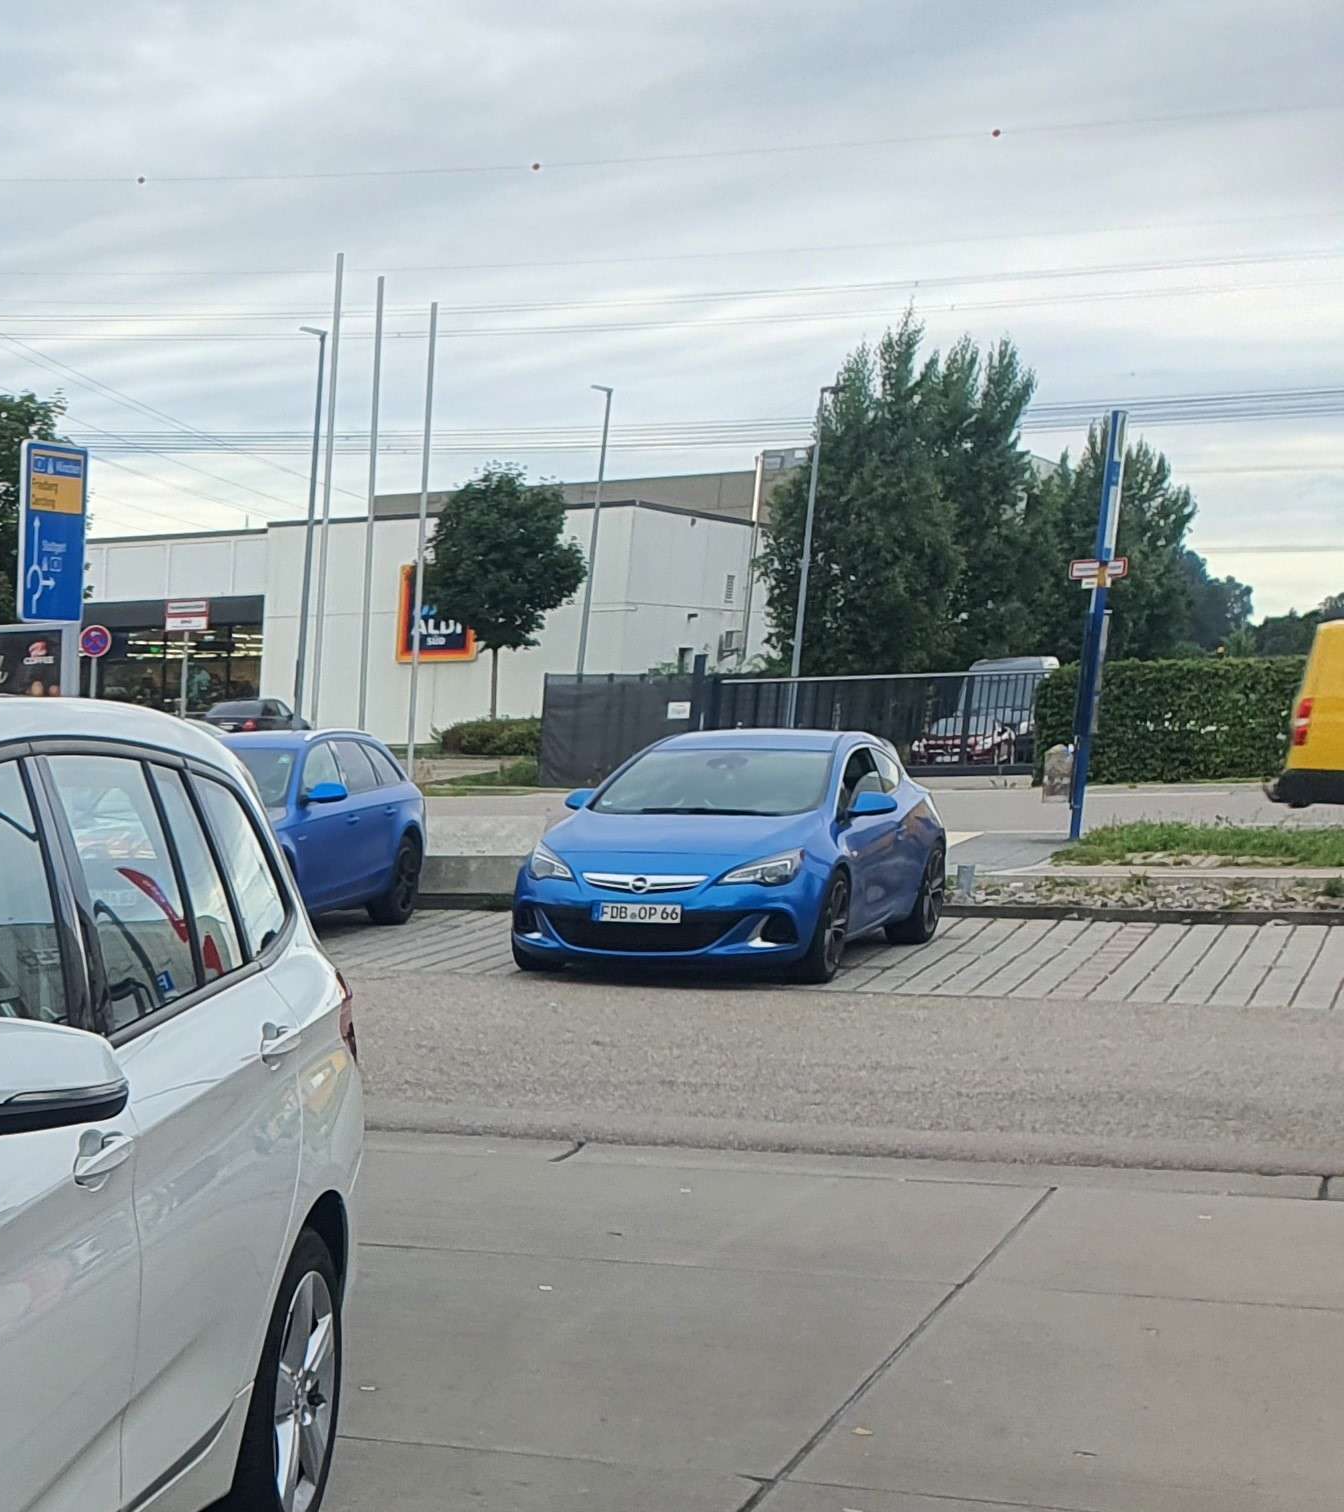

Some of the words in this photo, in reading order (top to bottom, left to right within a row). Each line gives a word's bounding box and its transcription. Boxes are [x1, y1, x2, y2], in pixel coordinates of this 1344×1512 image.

[601, 905, 628, 920] FDB
[638, 906, 657, 921] OP
[660, 907, 679, 921] 66
